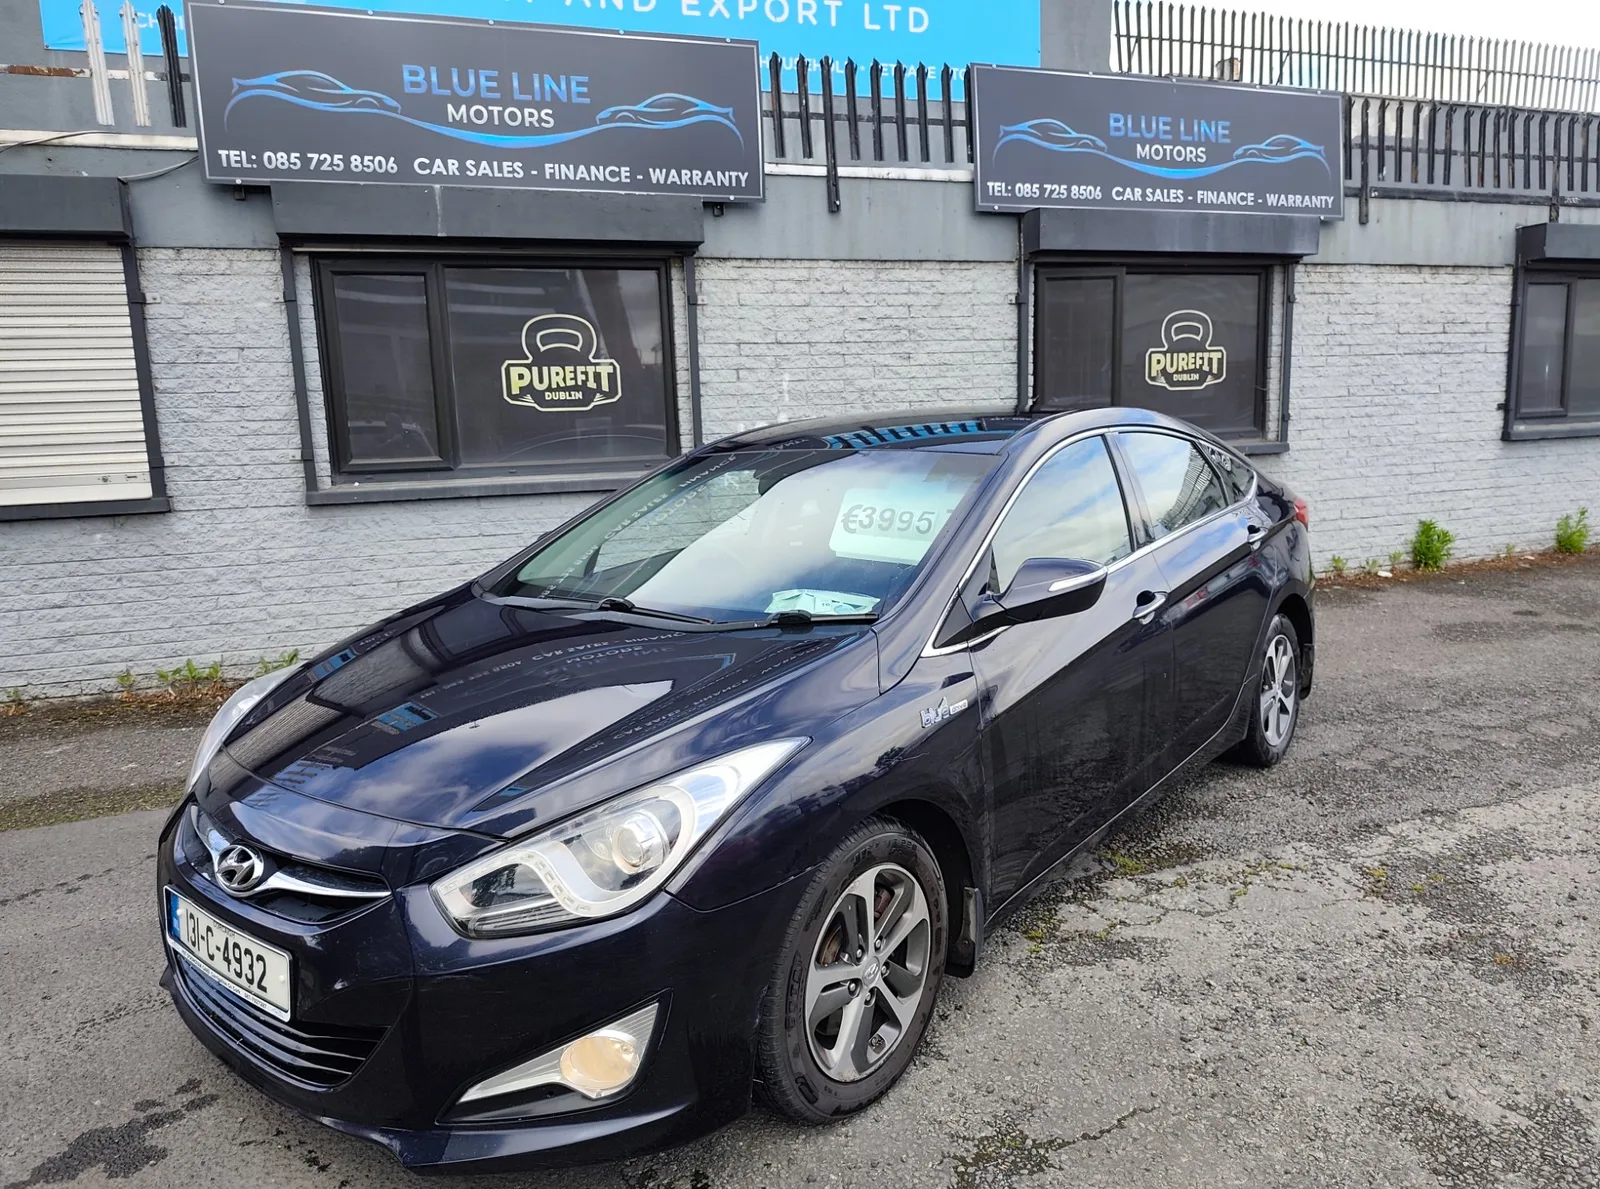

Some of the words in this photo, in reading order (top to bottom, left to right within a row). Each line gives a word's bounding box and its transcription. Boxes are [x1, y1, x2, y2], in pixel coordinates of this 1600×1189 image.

[681, 0, 843, 27] EXPORT
[863, 3, 930, 33] LTD
[402, 64, 500, 98] BLUE
[512, 72, 591, 103] LINE
[447, 103, 555, 128] MOTORS
[1109, 113, 1172, 140] BLUE
[1180, 118, 1231, 143] LINE
[1136, 143, 1207, 163] MOTORS
[218, 150, 257, 168] TEL:
[263, 151, 301, 170] 085
[306, 153, 344, 171] 725
[350, 154, 398, 173] 8506
[413, 157, 460, 176] CAR
[465, 159, 524, 178] SALES
[544, 163, 631, 182] FINANCE
[649, 168, 749, 187] WARRANTY
[987, 181, 1012, 197] TEL:
[1015, 183, 1039, 198] 085
[1044, 184, 1067, 199] 725
[1071, 185, 1102, 200] 8506
[1112, 186, 1142, 201] CAR
[1145, 188, 1184, 203] SALES
[1197, 190, 1254, 206] FINANCE
[1266, 193, 1334, 209] WARRANTY
[1151, 351, 1222, 377] PUREFIT
[1173, 373, 1199, 382] DUBLIN
[509, 365, 613, 395] PUREFIT
[545, 391, 583, 400] DUBLIN
[841, 504, 935, 535] €3995
[185, 908, 268, 994] 131-C-4932
